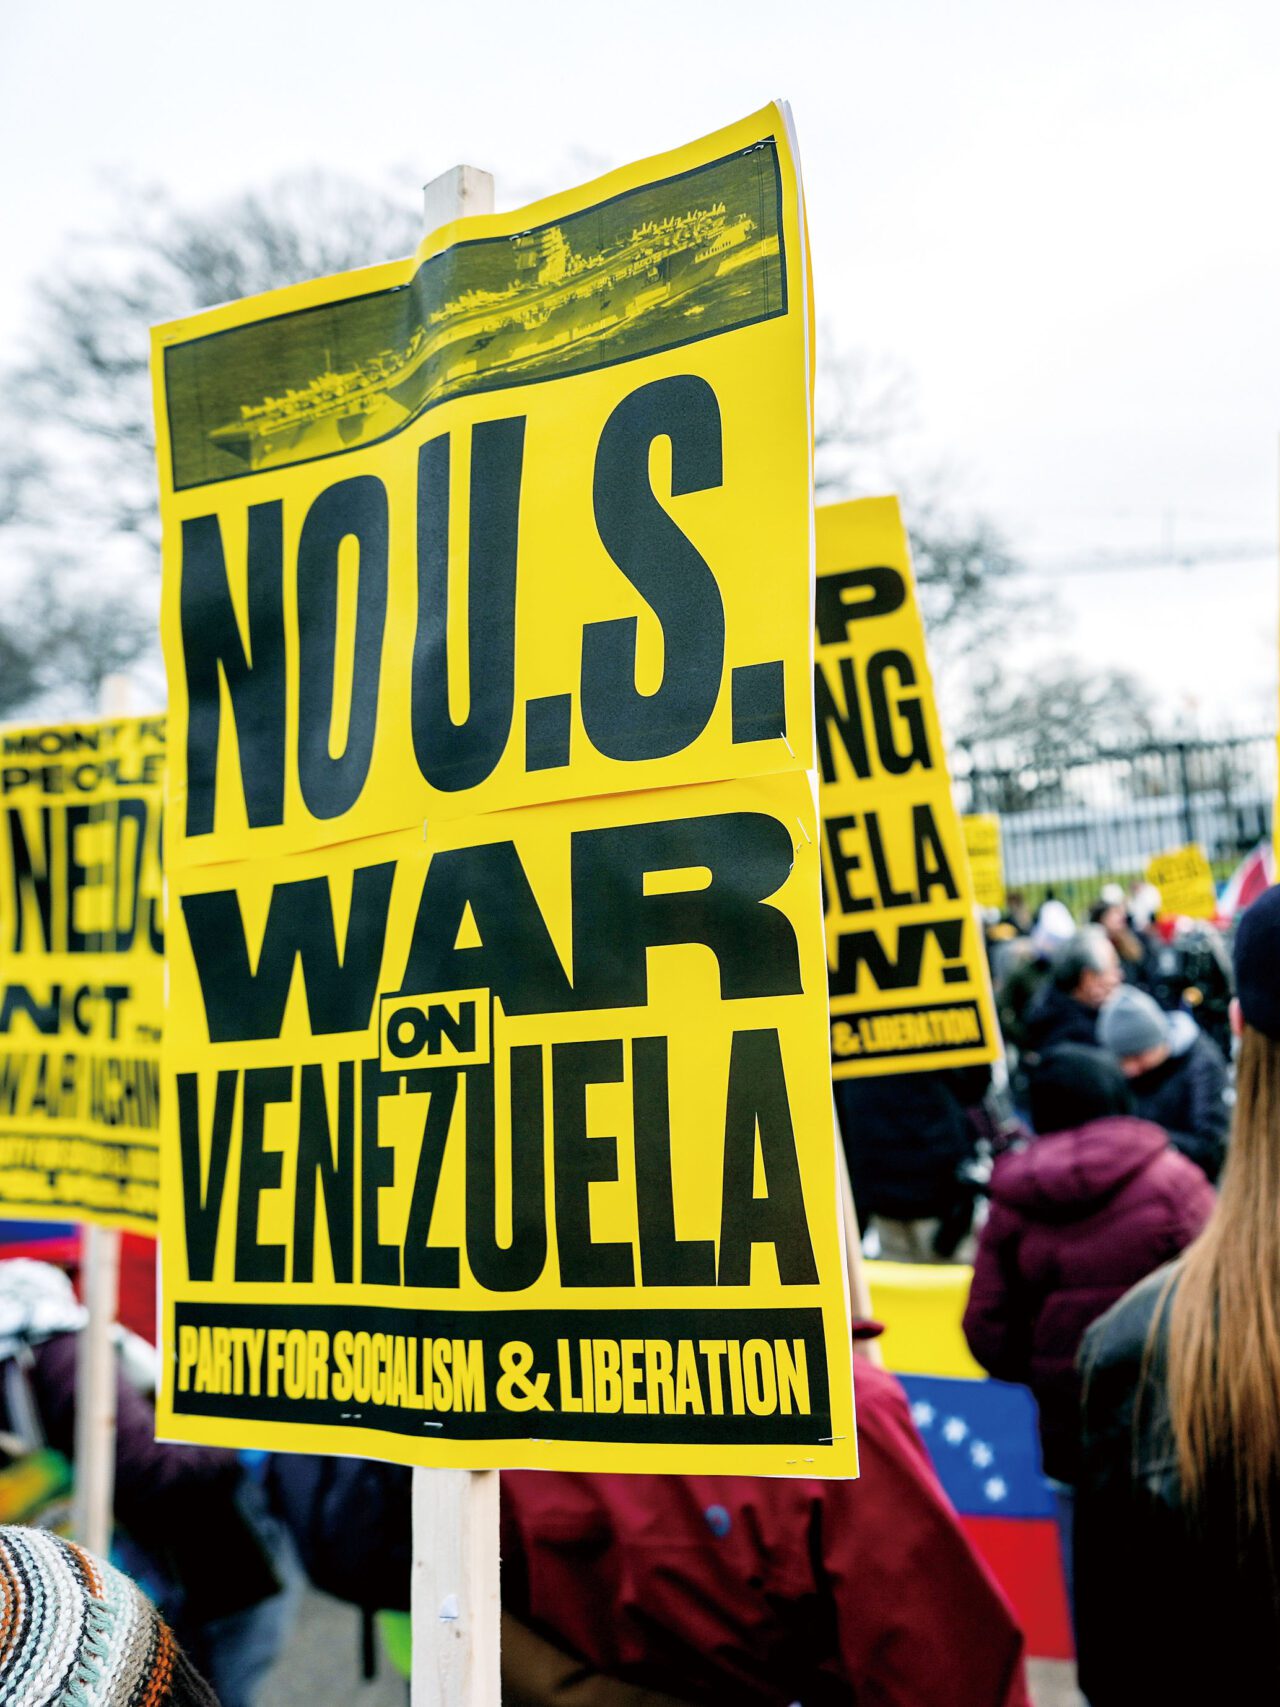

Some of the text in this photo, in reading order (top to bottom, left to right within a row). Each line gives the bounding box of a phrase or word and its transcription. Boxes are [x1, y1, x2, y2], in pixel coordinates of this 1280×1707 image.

[180, 374, 787, 838] NO U.S.
[181, 811, 804, 1043] WAR
[386, 1001, 476, 1058] ON
[832, 1022, 861, 1056] &
[175, 1027, 820, 1292] VENEZUELA
[178, 1326, 812, 1416] PARTY FOR SOCIALISM & LIBERATION
